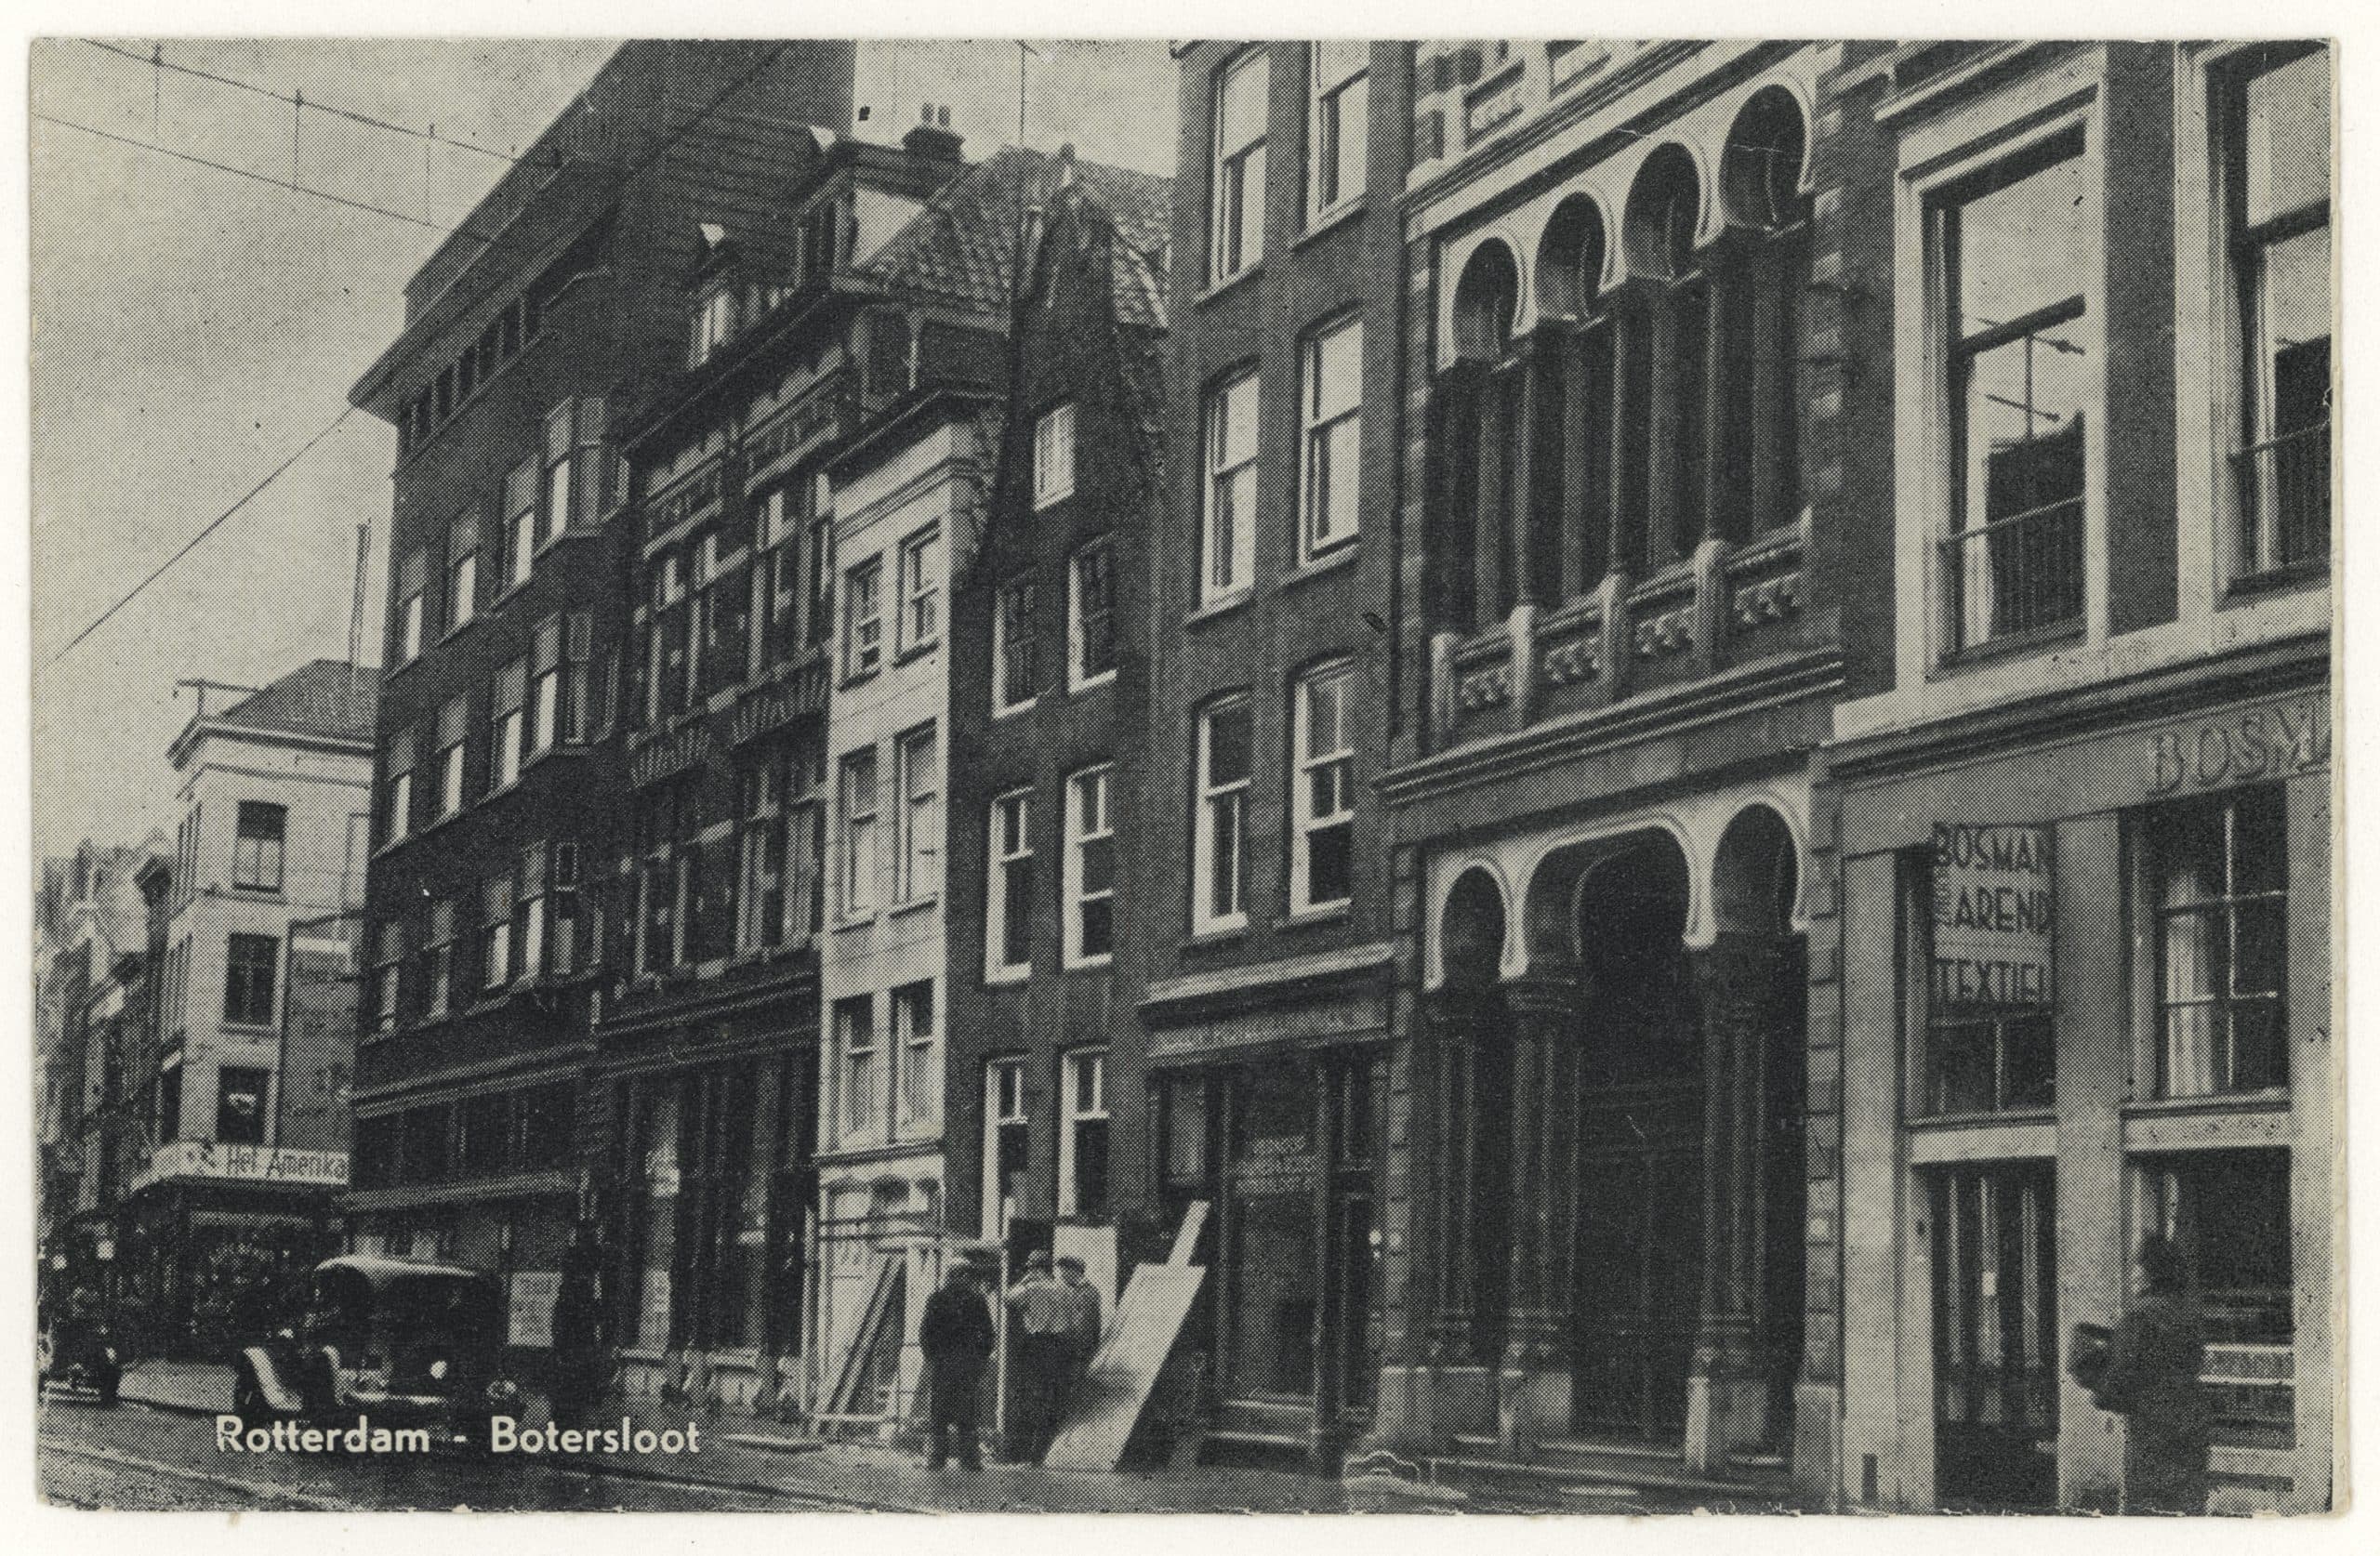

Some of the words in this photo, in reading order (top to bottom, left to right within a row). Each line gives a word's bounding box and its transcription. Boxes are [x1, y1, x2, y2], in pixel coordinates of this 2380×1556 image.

[2146, 701, 2330, 798] BOSM
[1933, 822, 2052, 874] BOSMAN
[1954, 885, 2051, 936] AREND
[227, 1144, 258, 1176] Het
